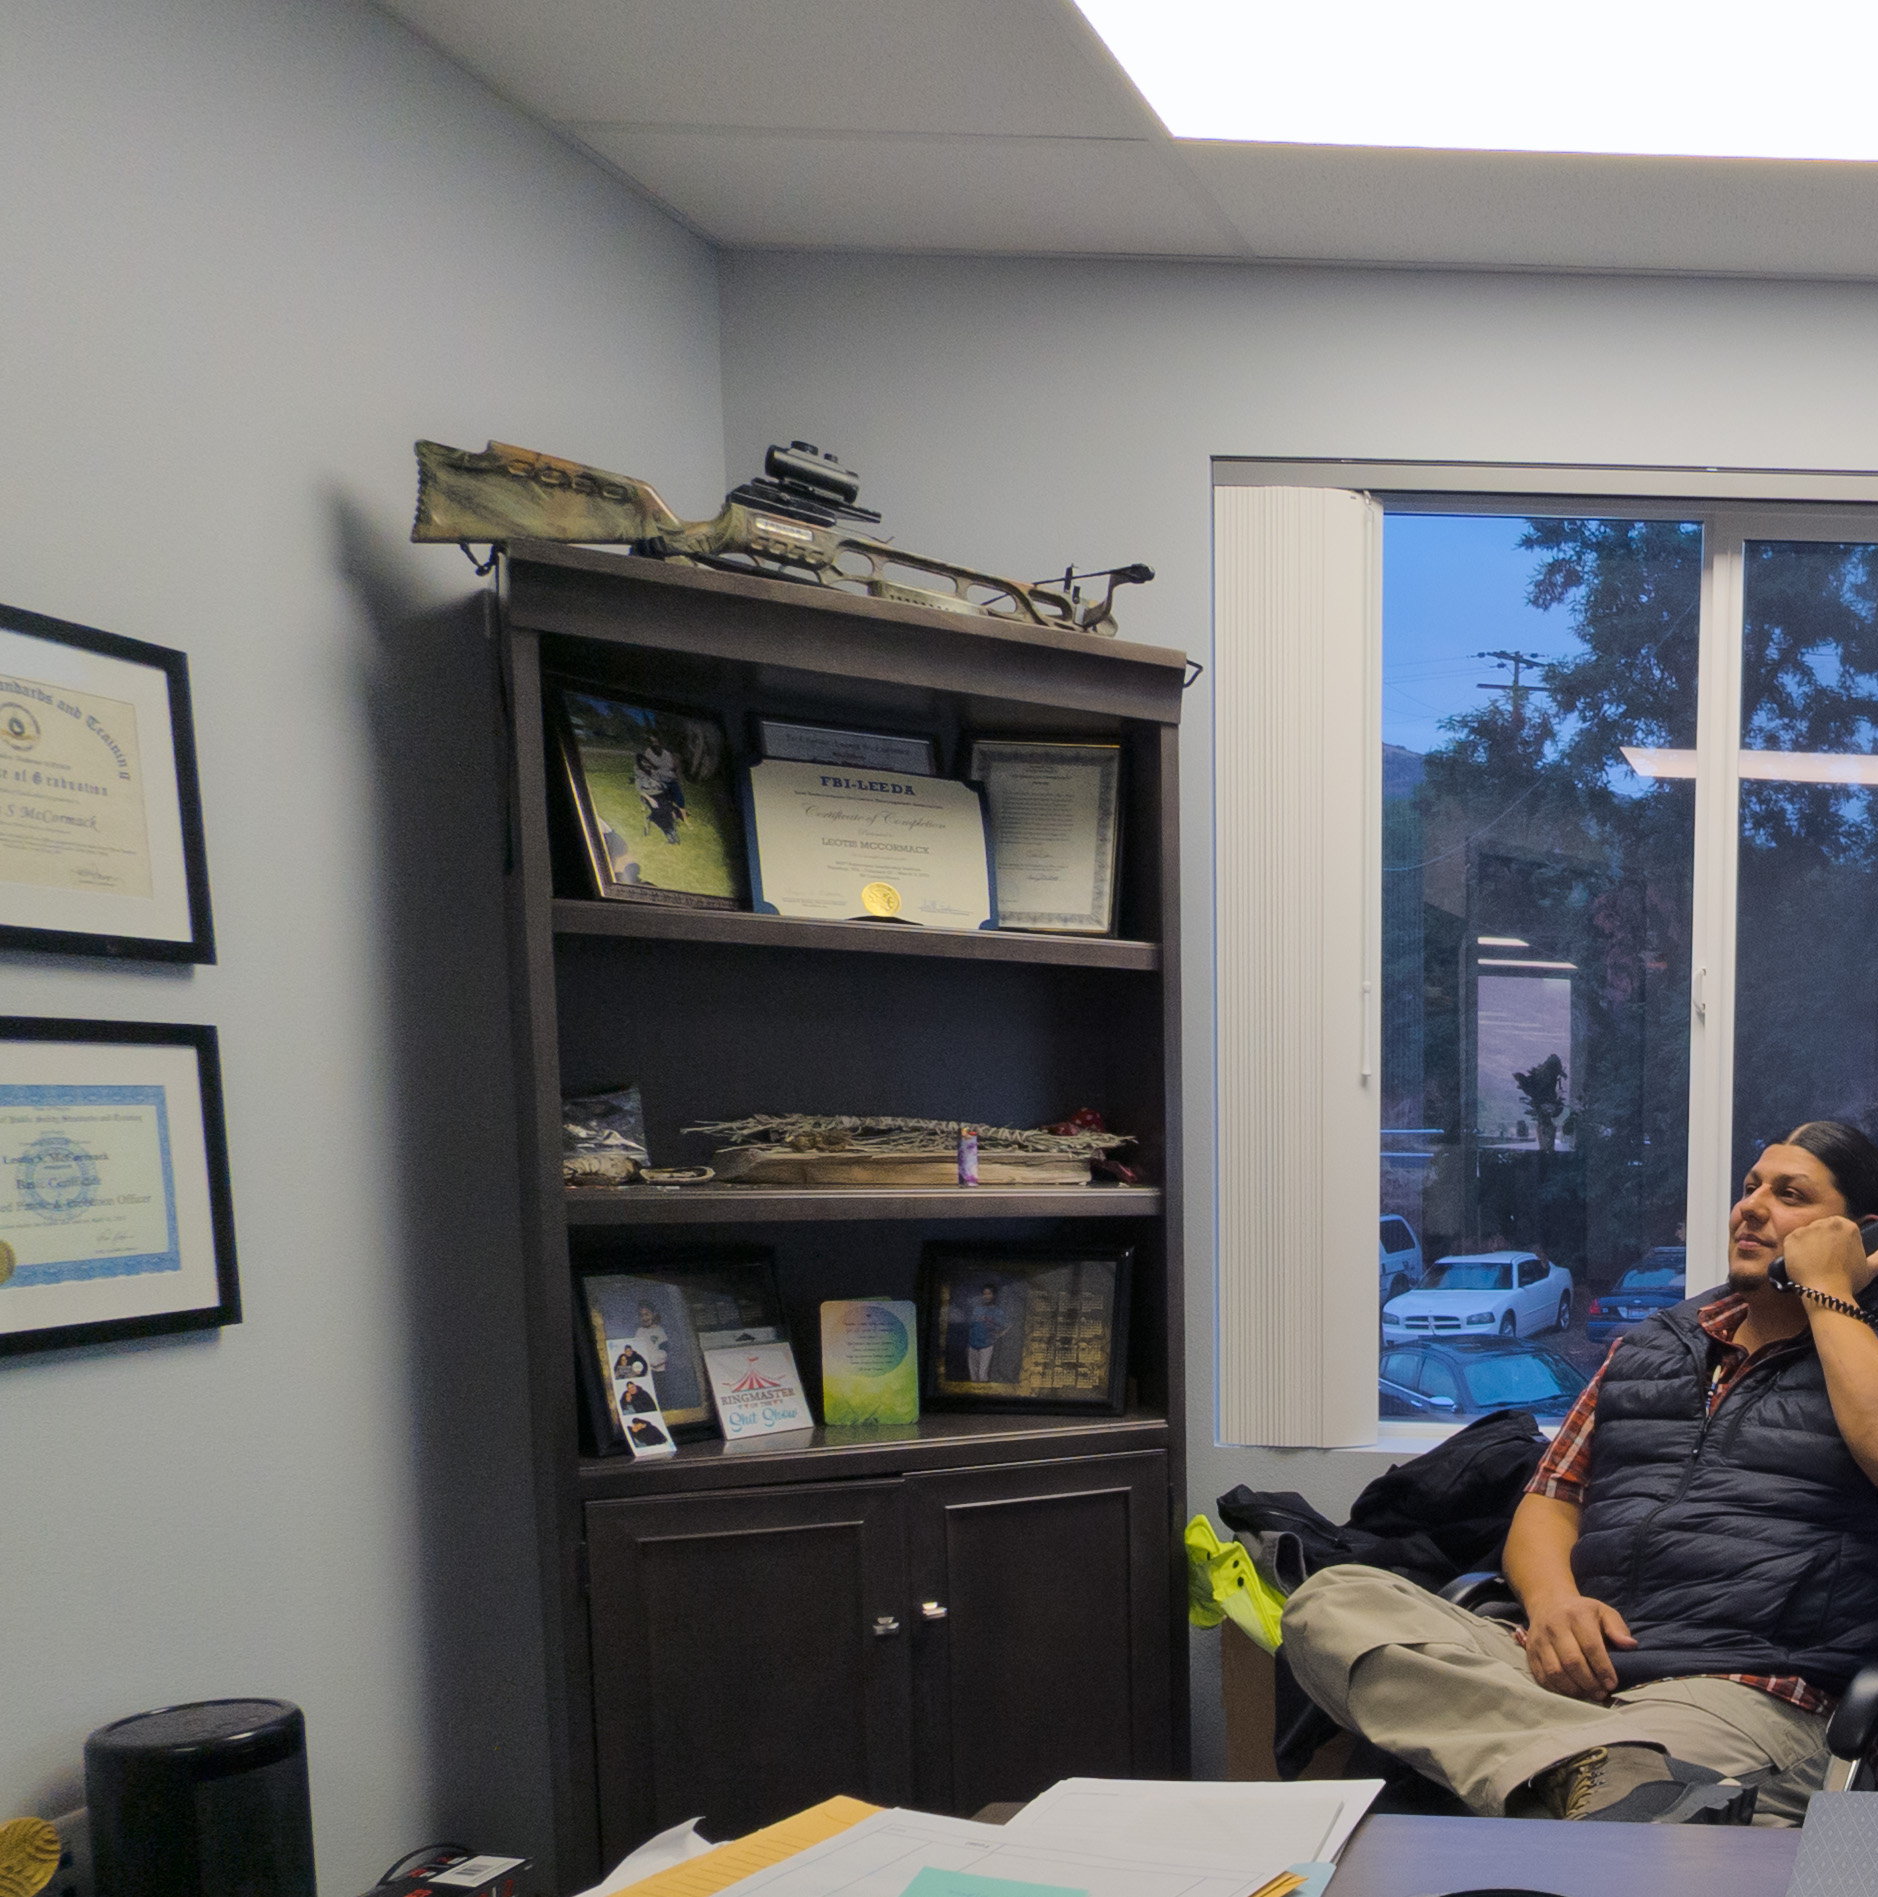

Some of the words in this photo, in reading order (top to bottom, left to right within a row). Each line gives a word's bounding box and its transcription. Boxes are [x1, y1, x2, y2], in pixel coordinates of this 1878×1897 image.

[57, 699, 82, 720] and
[86, 714, 132, 782] Training
[820, 775, 916, 796] FBI-LEEDA
[20, 805, 101, 833] McCormack
[802, 802, 864, 822] Certificate
[881, 810, 947, 833] Completion
[821, 837, 858, 849] LEOTIS
[860, 841, 930, 855] MCCORMACK
[721, 1387, 796, 1407] RINGMASTER
[729, 1411, 757, 1433] Shit
[762, 1407, 798, 1428] Show
